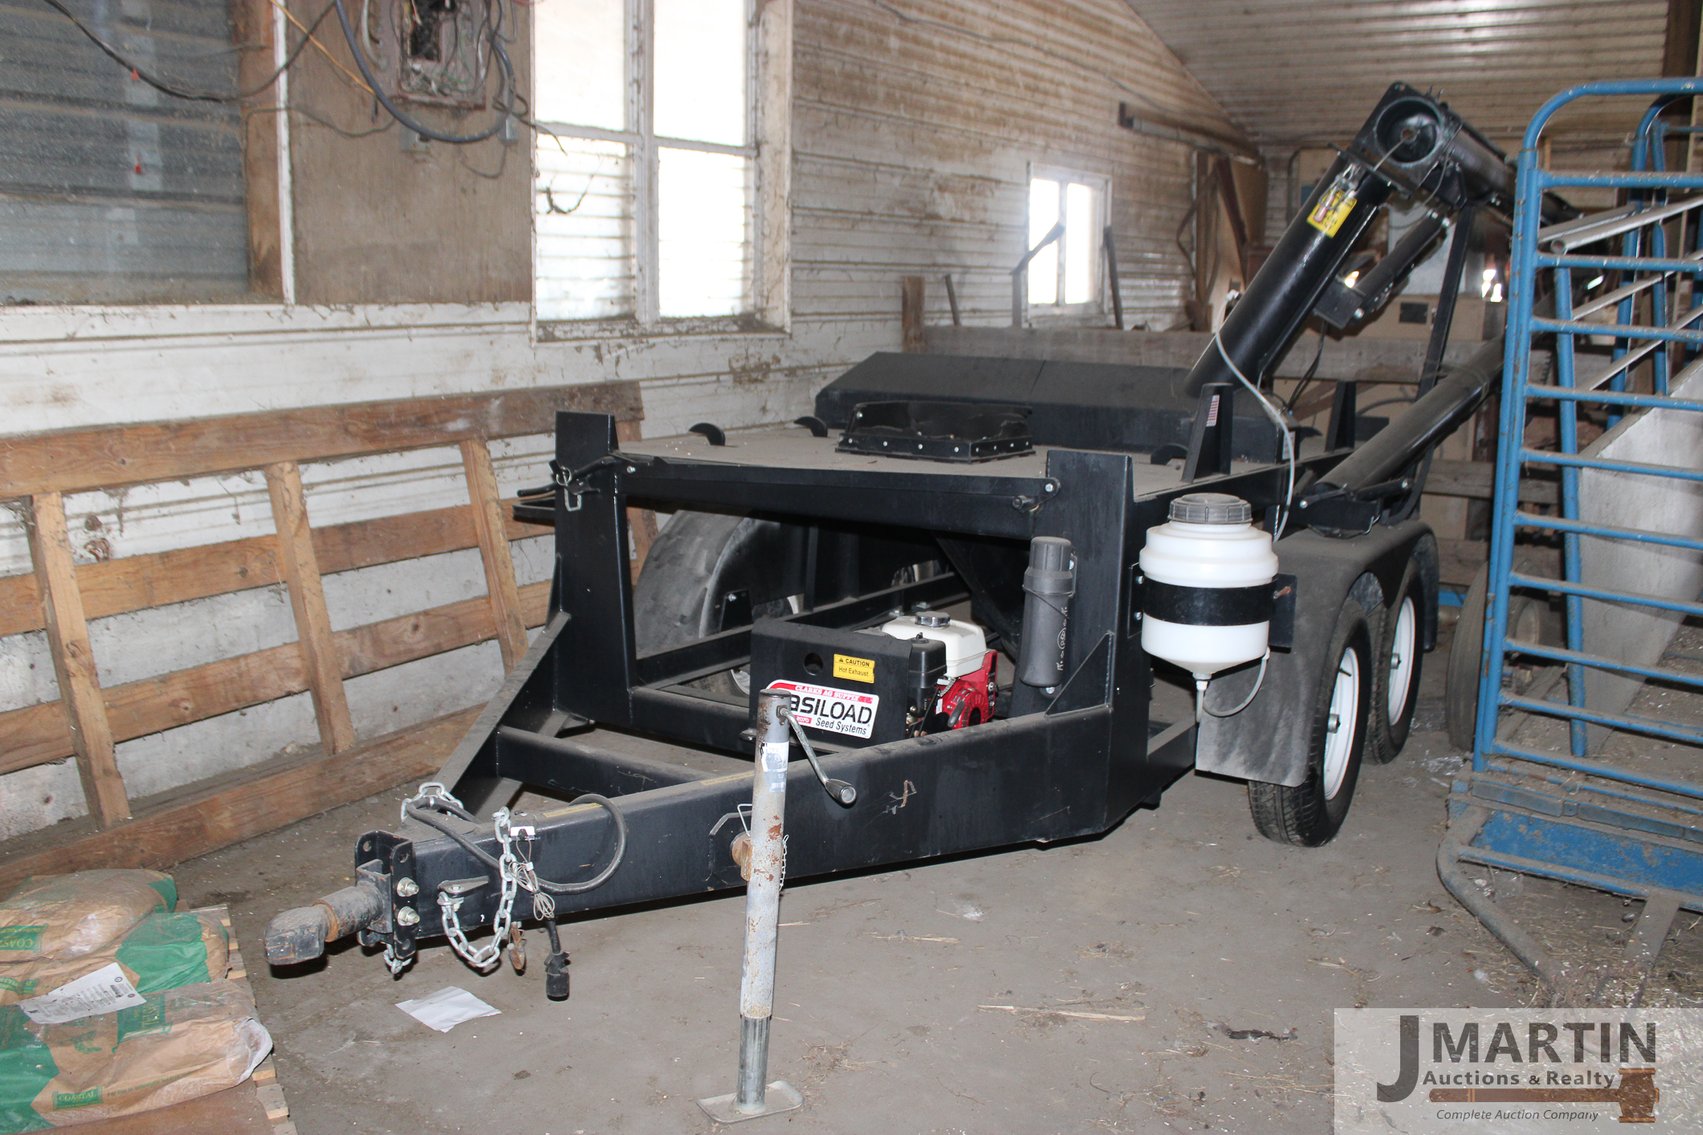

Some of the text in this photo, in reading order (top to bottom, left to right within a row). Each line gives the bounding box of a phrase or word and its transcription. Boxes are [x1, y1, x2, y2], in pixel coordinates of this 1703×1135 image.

[846, 658, 870, 667] CAUTION
[848, 667, 869, 677] Exhaust
[815, 717, 834, 729] Seed
[835, 720, 868, 736] Systems
